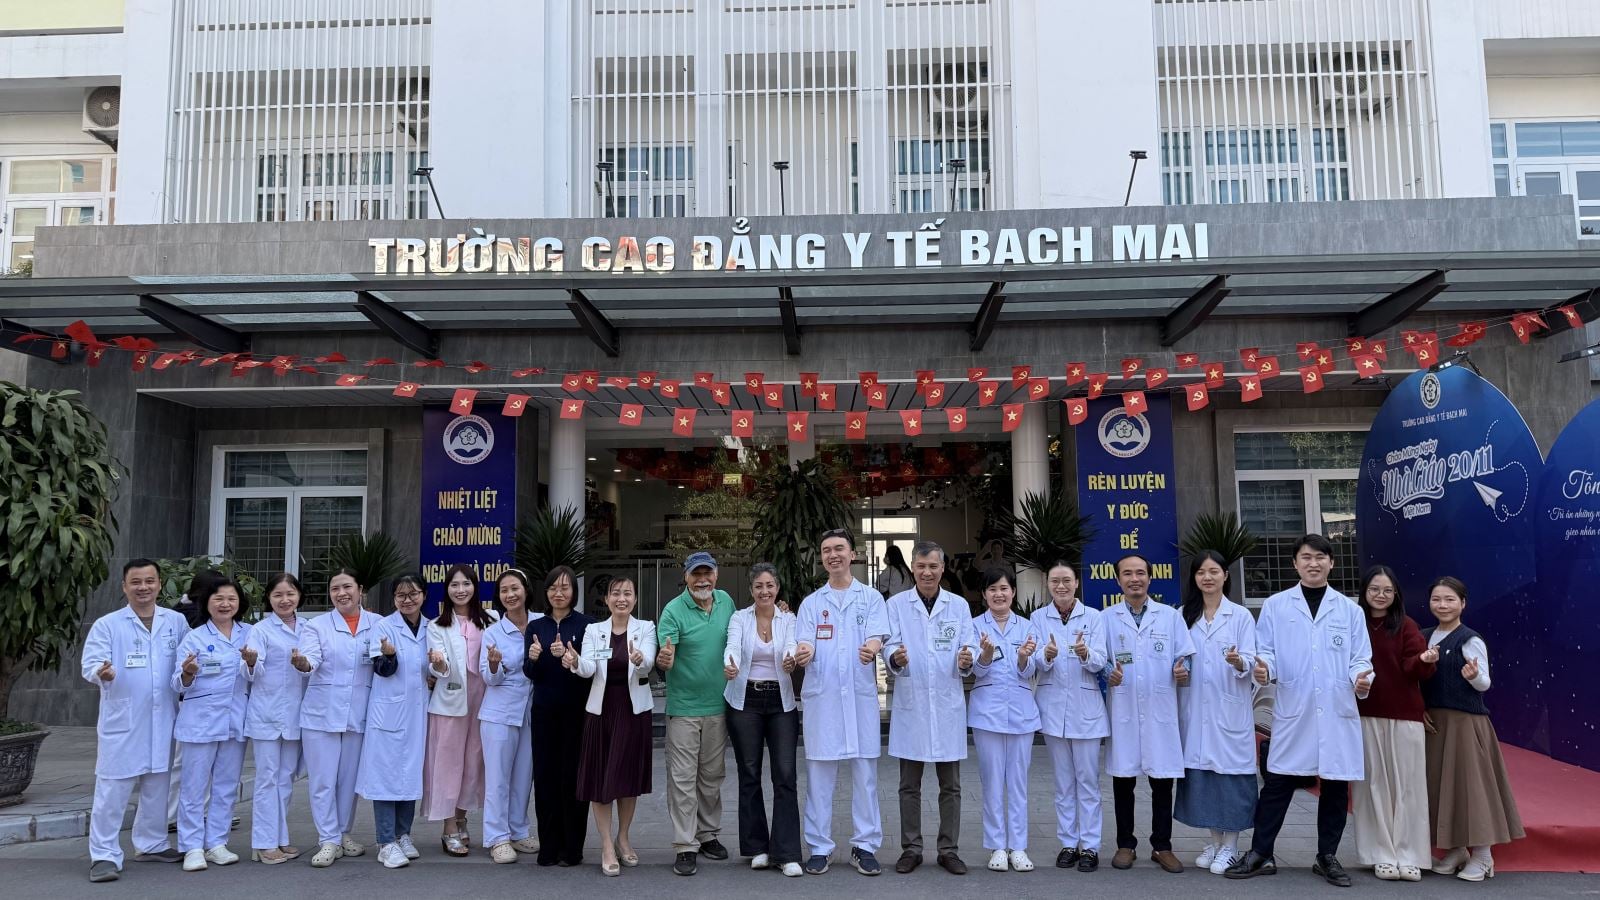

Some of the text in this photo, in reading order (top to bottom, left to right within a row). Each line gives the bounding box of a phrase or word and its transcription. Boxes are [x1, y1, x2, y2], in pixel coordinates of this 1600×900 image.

[368, 228, 564, 275] TRƯỜNG
[581, 236, 675, 274] CAO
[691, 217, 826, 273] ĐẲNG
[843, 233, 871, 268] Y
[887, 218, 946, 268] TẾ
[1112, 222, 1209, 263] MAI
[1416, 416, 1425, 426] CAO
[1458, 407, 1468, 417] MAI
[1448, 444, 1495, 482] 20/11
[1088, 471, 1165, 493] RÈN LUYỆN
[438, 486, 498, 514] NHIỆT LIỆT
[1107, 501, 1149, 519] Y ĐỨC
[1415, 502, 1431, 517] Nam
[433, 522, 502, 546] CHÀO MỪNG
[1120, 527, 1139, 549] ĐỂ
[1090, 561, 1117, 579] XỨN
